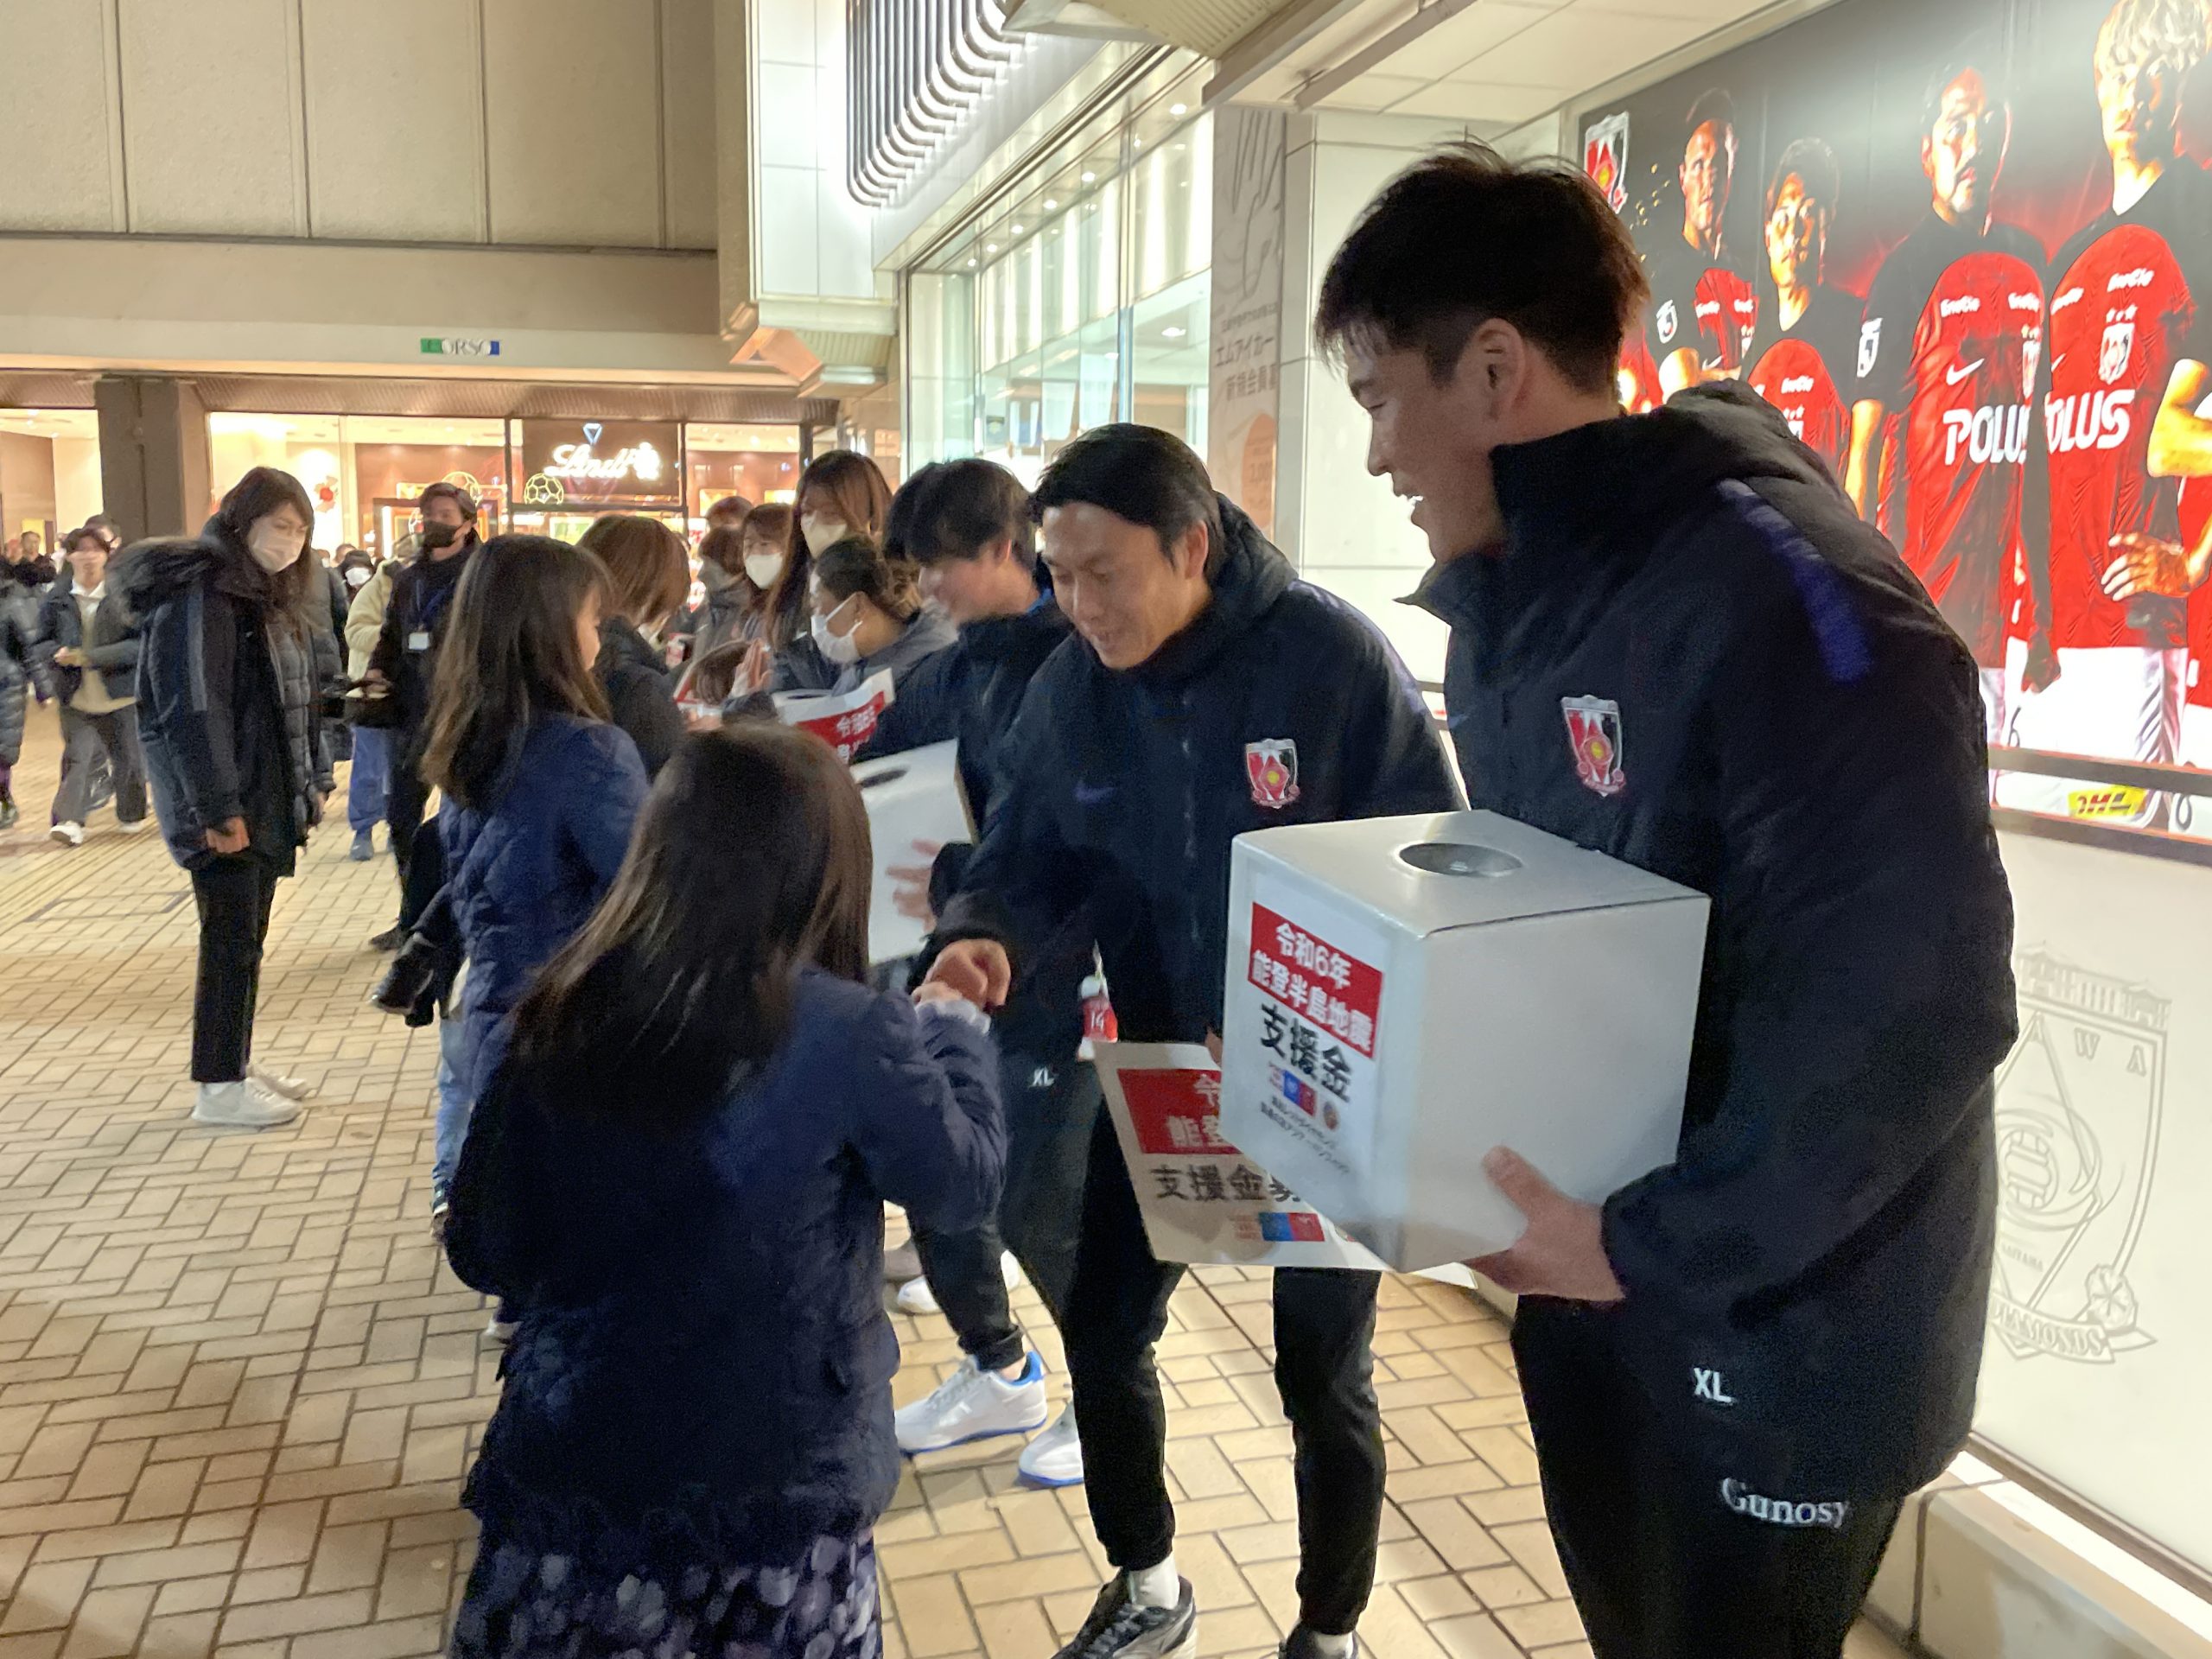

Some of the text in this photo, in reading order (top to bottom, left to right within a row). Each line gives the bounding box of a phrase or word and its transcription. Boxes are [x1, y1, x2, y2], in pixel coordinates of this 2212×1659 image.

[2044, 389, 2136, 454] OLUS
[1276, 923, 1352, 989] 令和6年
[1251, 949, 1373, 1052] 能登半島地震
[1261, 1002, 1351, 1103] 支援金
[1693, 1367, 1735, 1406] XL
[1720, 1477, 1849, 1529] Gunosy
